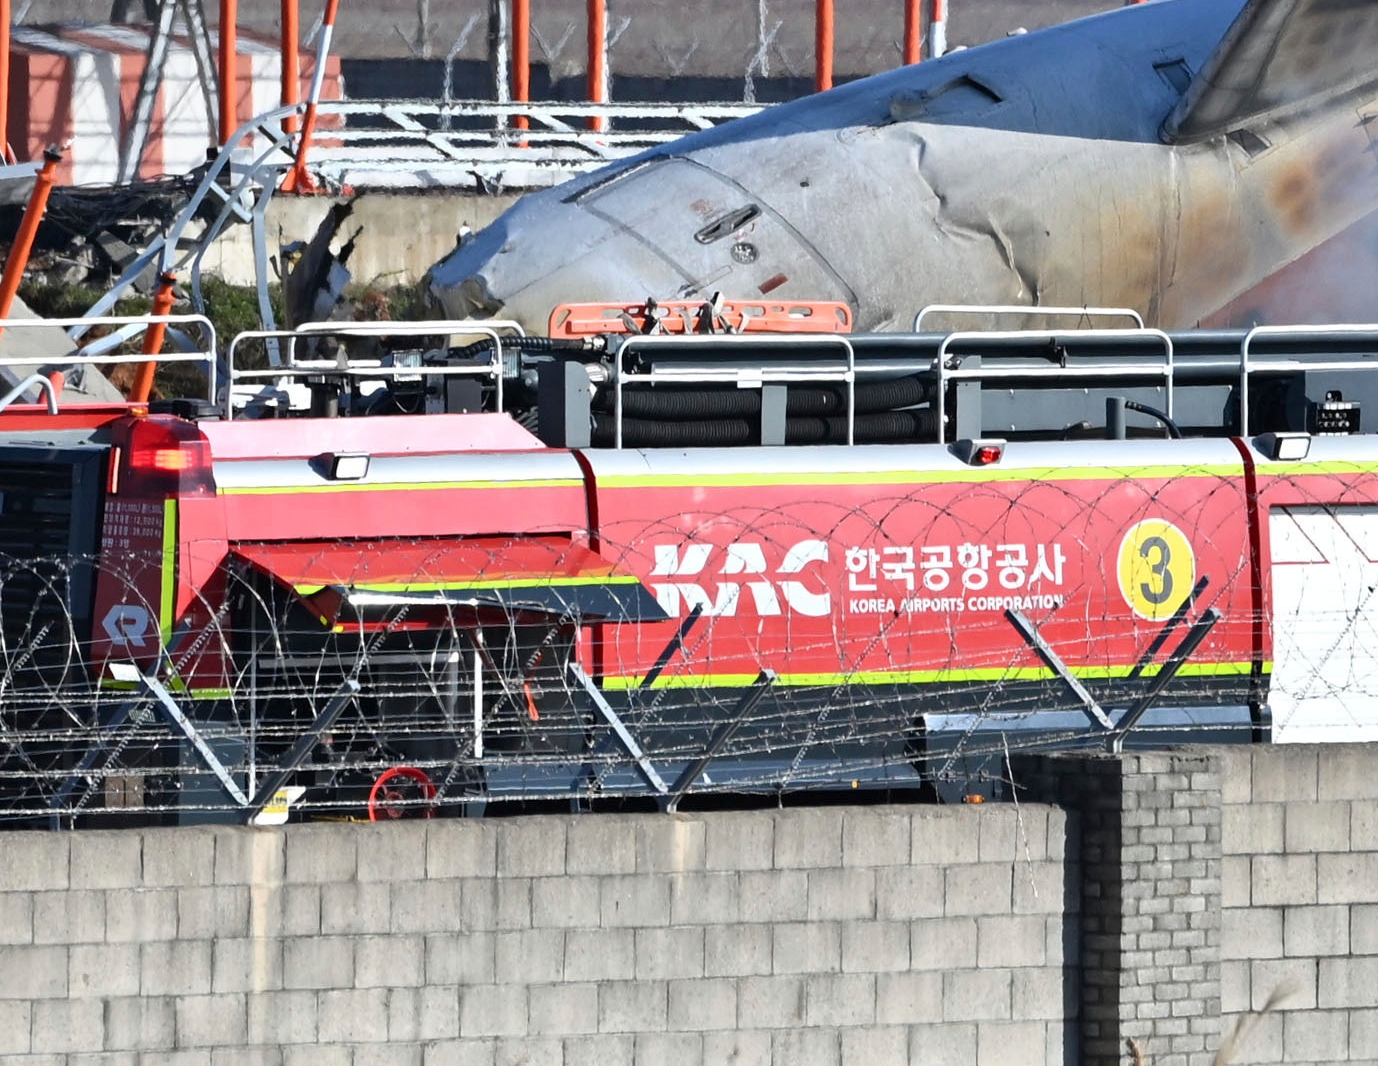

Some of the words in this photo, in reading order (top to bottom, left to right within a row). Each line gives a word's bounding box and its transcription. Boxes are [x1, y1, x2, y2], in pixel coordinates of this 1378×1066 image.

[649, 540, 831, 617] KAC
[845, 542, 1066, 591] 한국공항공사
[1140, 536, 1173, 604] 3
[850, 598, 895, 614] KOREA
[900, 596, 964, 613] AIRPORTS
[968, 594, 1064, 611] CORPORATION
